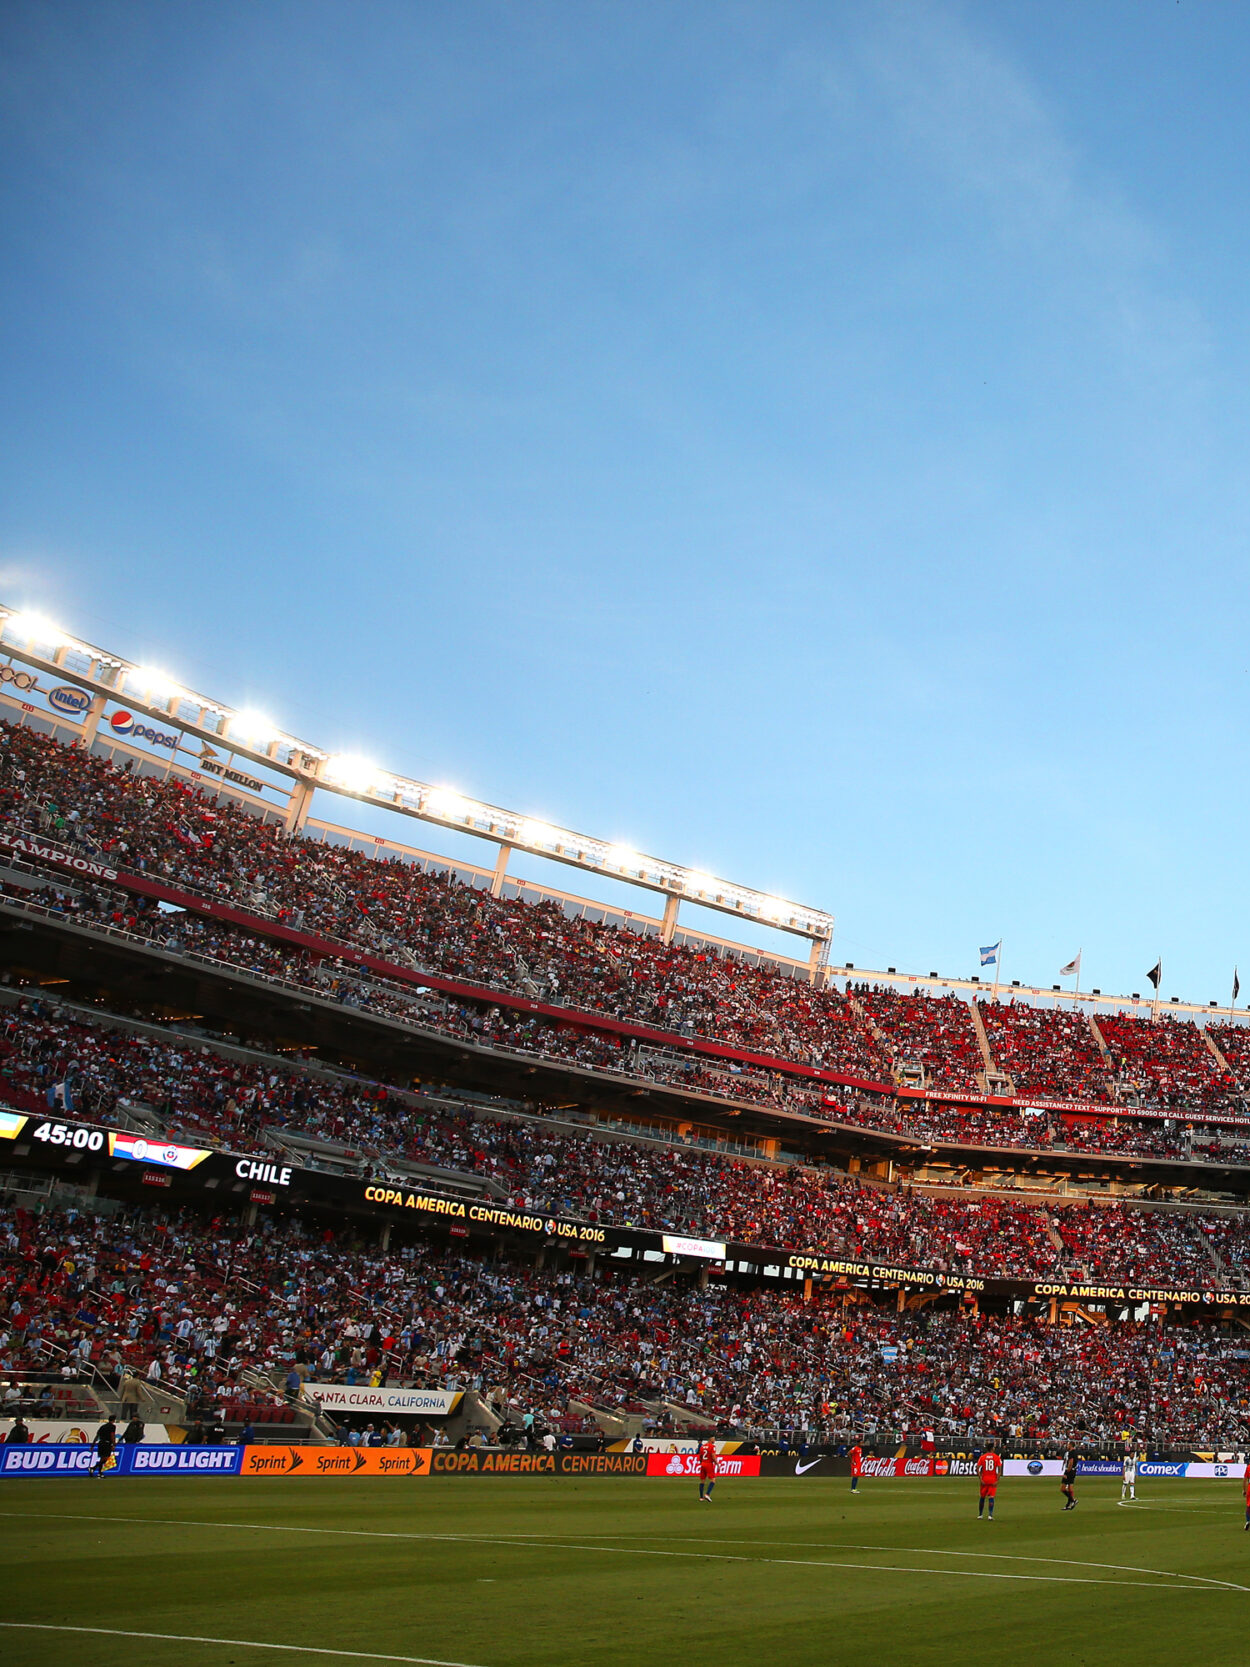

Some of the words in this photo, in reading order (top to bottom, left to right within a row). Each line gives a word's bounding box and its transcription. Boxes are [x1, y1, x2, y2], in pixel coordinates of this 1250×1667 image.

[55, 689, 85, 708] intel
[133, 724, 178, 749] pepsi
[201, 760, 223, 776] BNY
[224, 767, 263, 792] MELLON
[0, 832, 118, 880] HAMPIONS
[943, 1093, 969, 1101] XFINITY
[1031, 1100, 1073, 1110] ASSISTANCE?
[1091, 1105, 1127, 1114] "SUPPORT"
[1205, 1114, 1234, 1123] SERVICES
[33, 1123, 104, 1151] 45:00
[132, 1140, 148, 1159] 0
[236, 1159, 292, 1186] CHILE
[365, 1186, 403, 1207] COPA
[405, 1193, 466, 1218] AMERICA
[469, 1206, 543, 1232] CENTENARIO
[557, 1223, 579, 1239] USA
[579, 1227, 605, 1243] 2016
[789, 1255, 819, 1269] COPA
[821, 1259, 870, 1277] AMERICA
[872, 1266, 934, 1284] CENTENARIO
[946, 1277, 965, 1289] USA
[965, 1279, 985, 1291] 2016
[1034, 1283, 1067, 1296] COPA
[1070, 1286, 1125, 1299] AMERICA
[1128, 1288, 1200, 1302] CENTENARIO
[1216, 1293, 1238, 1305] USA
[312, 1391, 346, 1404] SANTA
[349, 1393, 385, 1407] CLARA,
[387, 1395, 446, 1408] CALIFORNIA
[5, 1451, 56, 1470] BUD
[134, 1451, 171, 1469] BUD
[172, 1452, 233, 1468] LIGHT
[250, 1454, 287, 1472] Sprint
[317, 1455, 351, 1472] Sprint
[433, 1453, 480, 1472] COPA
[482, 1454, 556, 1472] AMERICA
[561, 1455, 646, 1473] CENTENARIO
[702, 1449, 708, 1460] 2
[379, 1456, 411, 1473] Sprint
[684, 1456, 702, 1474] Sta
[985, 1459, 994, 1471] 18
[1081, 1463, 1122, 1473] head&shoulders
[1139, 1463, 1183, 1475] Comex
